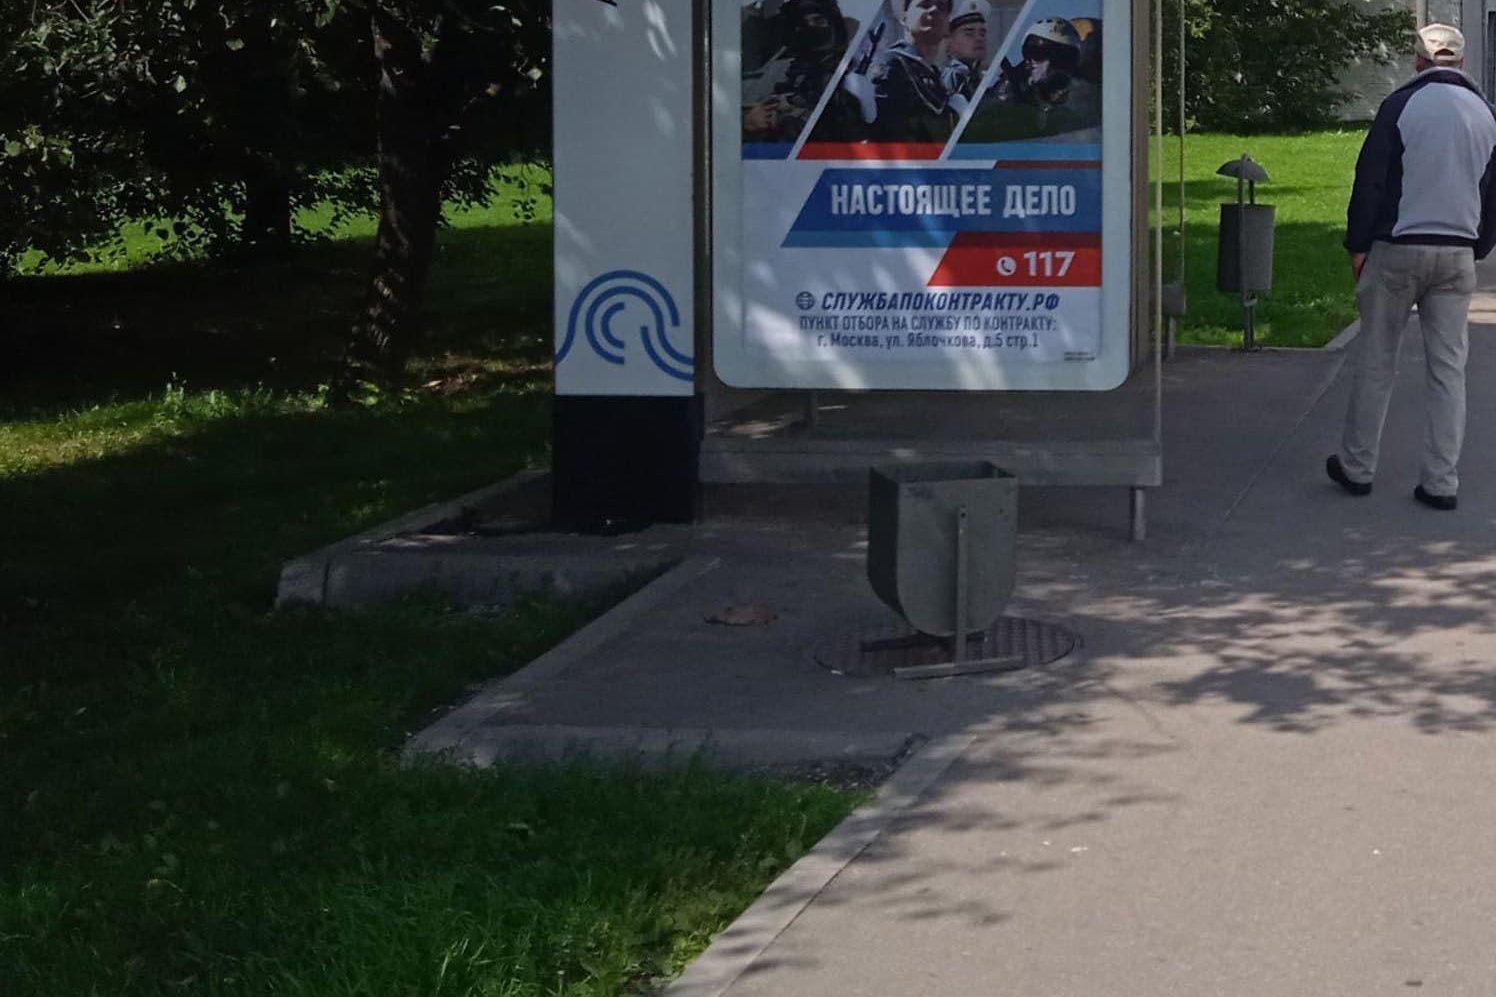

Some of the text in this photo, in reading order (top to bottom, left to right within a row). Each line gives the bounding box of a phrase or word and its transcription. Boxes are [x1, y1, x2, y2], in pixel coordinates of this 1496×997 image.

[831, 185, 1075, 218] НАСТОЯЩЕЕ ДЕЛО
[1023, 251, 1075, 277] 117
[821, 292, 1060, 311] СЛУЖБАПОКОНТРАКТУ.РФ
[801, 316, 1056, 331] ПУНКТ ОТБОРА НА СЛУЖБУ ПО КОНТРАКТУ:
[831, 335, 883, 349] Москва,
[886, 337, 904, 349] ул.
[908, 334, 980, 349] Яблочкова,
